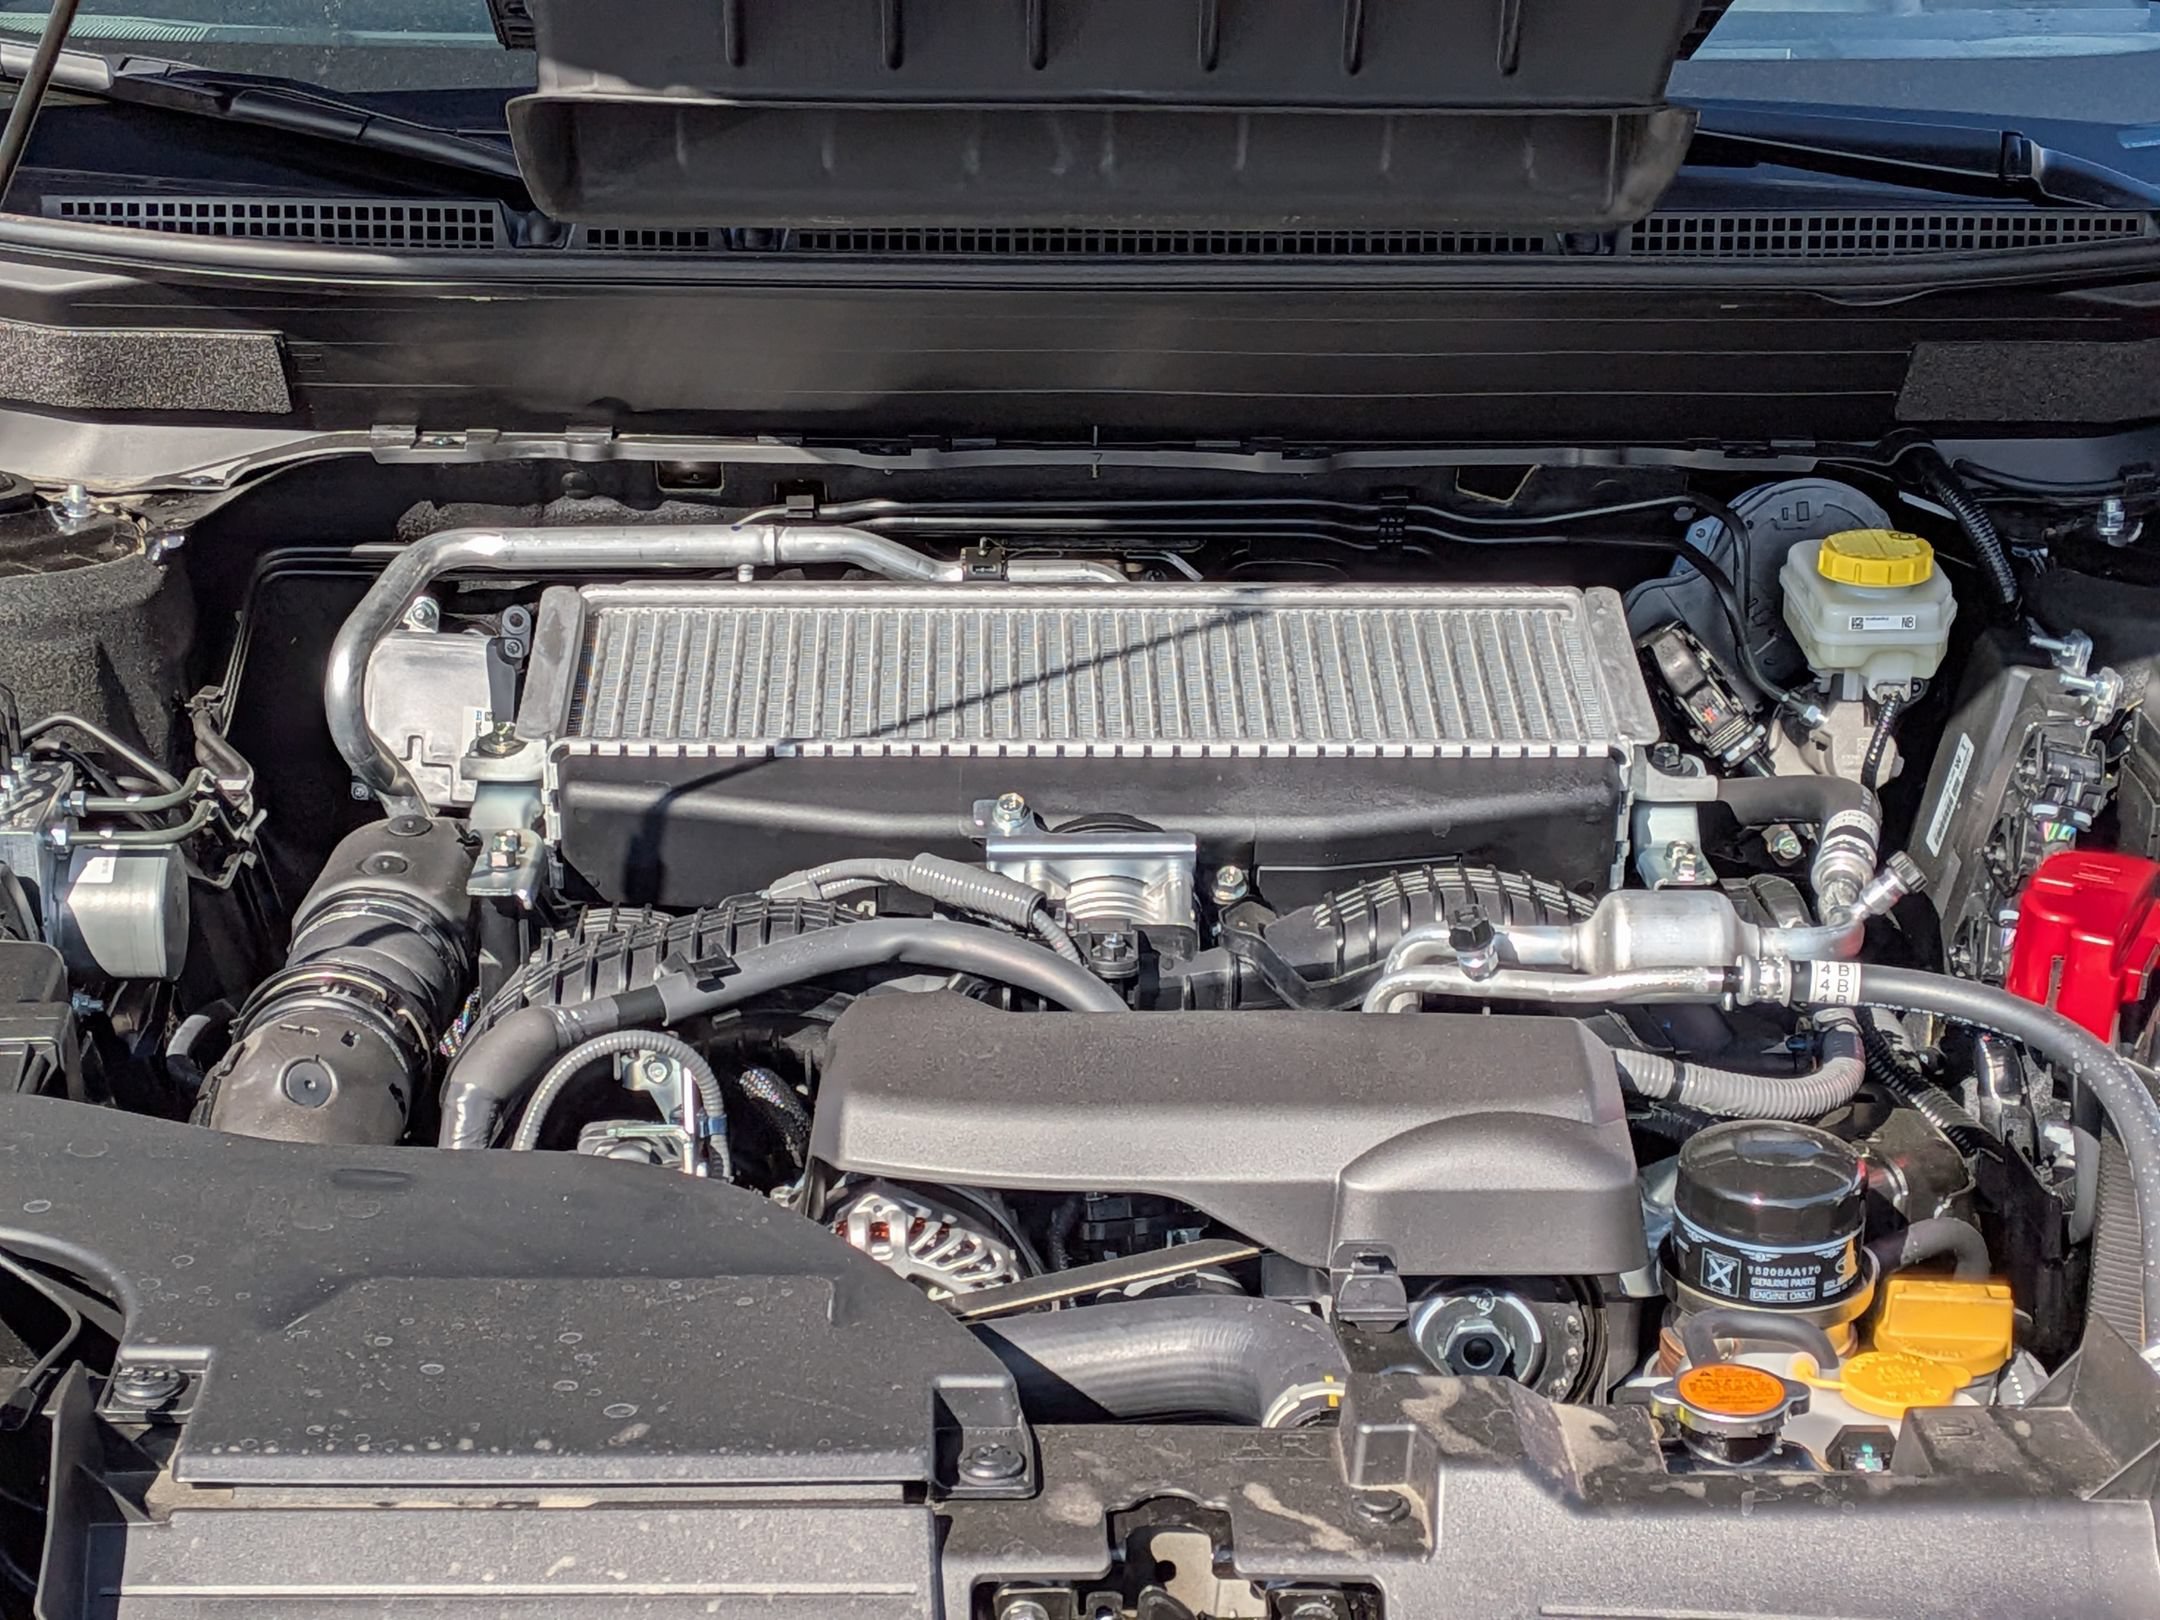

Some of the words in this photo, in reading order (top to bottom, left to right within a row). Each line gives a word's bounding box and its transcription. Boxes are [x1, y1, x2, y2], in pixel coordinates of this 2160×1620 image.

[1790, 1277, 1816, 1287] PARTS
[1752, 1289, 1788, 1300] ENGINE
[1789, 1289, 1813, 1300] ONLY
